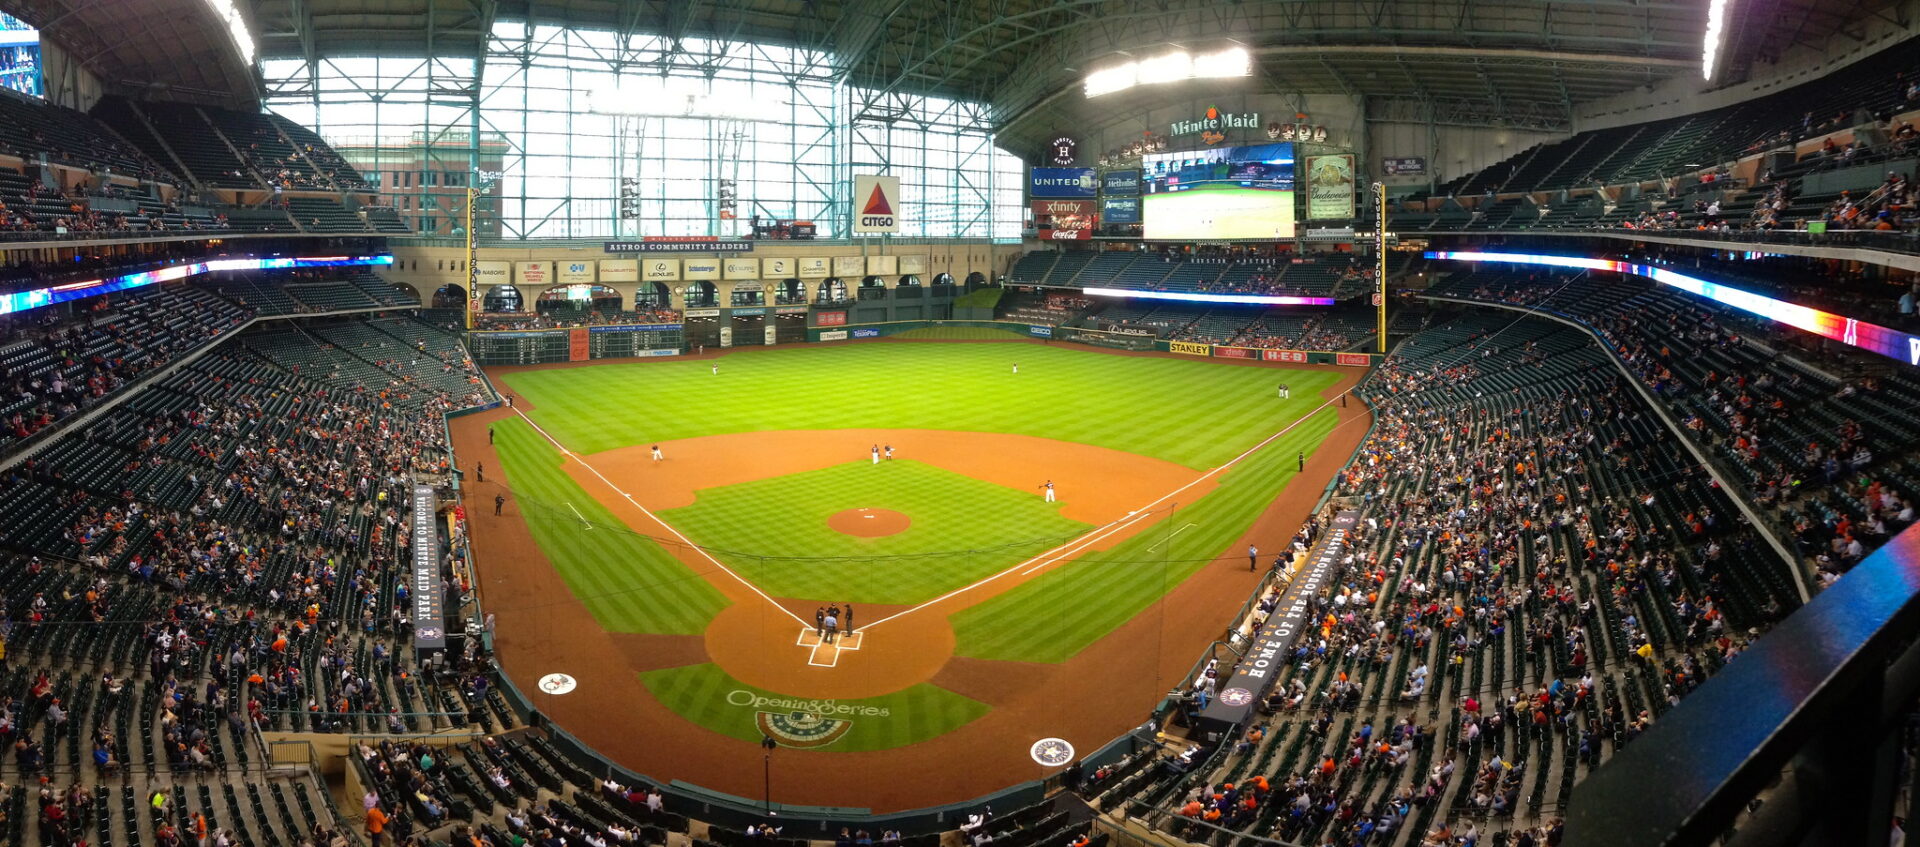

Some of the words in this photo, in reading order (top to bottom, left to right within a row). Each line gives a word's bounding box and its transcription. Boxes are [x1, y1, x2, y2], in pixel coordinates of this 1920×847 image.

[1221, 112, 1258, 128] Maid
[1053, 137, 1075, 146] HOUSTON
[1059, 146, 1069, 157] H
[1054, 157, 1074, 165] ASTROS
[1034, 178, 1080, 186] UNITED
[1310, 187, 1351, 200] Budweiser
[1047, 201, 1081, 213] xfinity
[861, 216, 894, 227] CITGO
[1031, 327, 1051, 336] GEICO
[1119, 328, 1148, 336] LEXUS
[1171, 344, 1208, 354] STANLEY
[416, 497, 427, 525] WELCOME
[417, 526, 427, 535] TO
[417, 537, 429, 566] MINUTE
[418, 568, 430, 591] MAID
[418, 595, 432, 620] PARK
[1248, 640, 1281, 678] HOME
[1274, 622, 1294, 637] OF
[1286, 598, 1307, 619] THE
[1301, 557, 1333, 596] HOUSTON
[1239, 624, 1277, 675] WELCOME
[726, 690, 822, 711] Opening
[816, 699, 890, 717] Series
